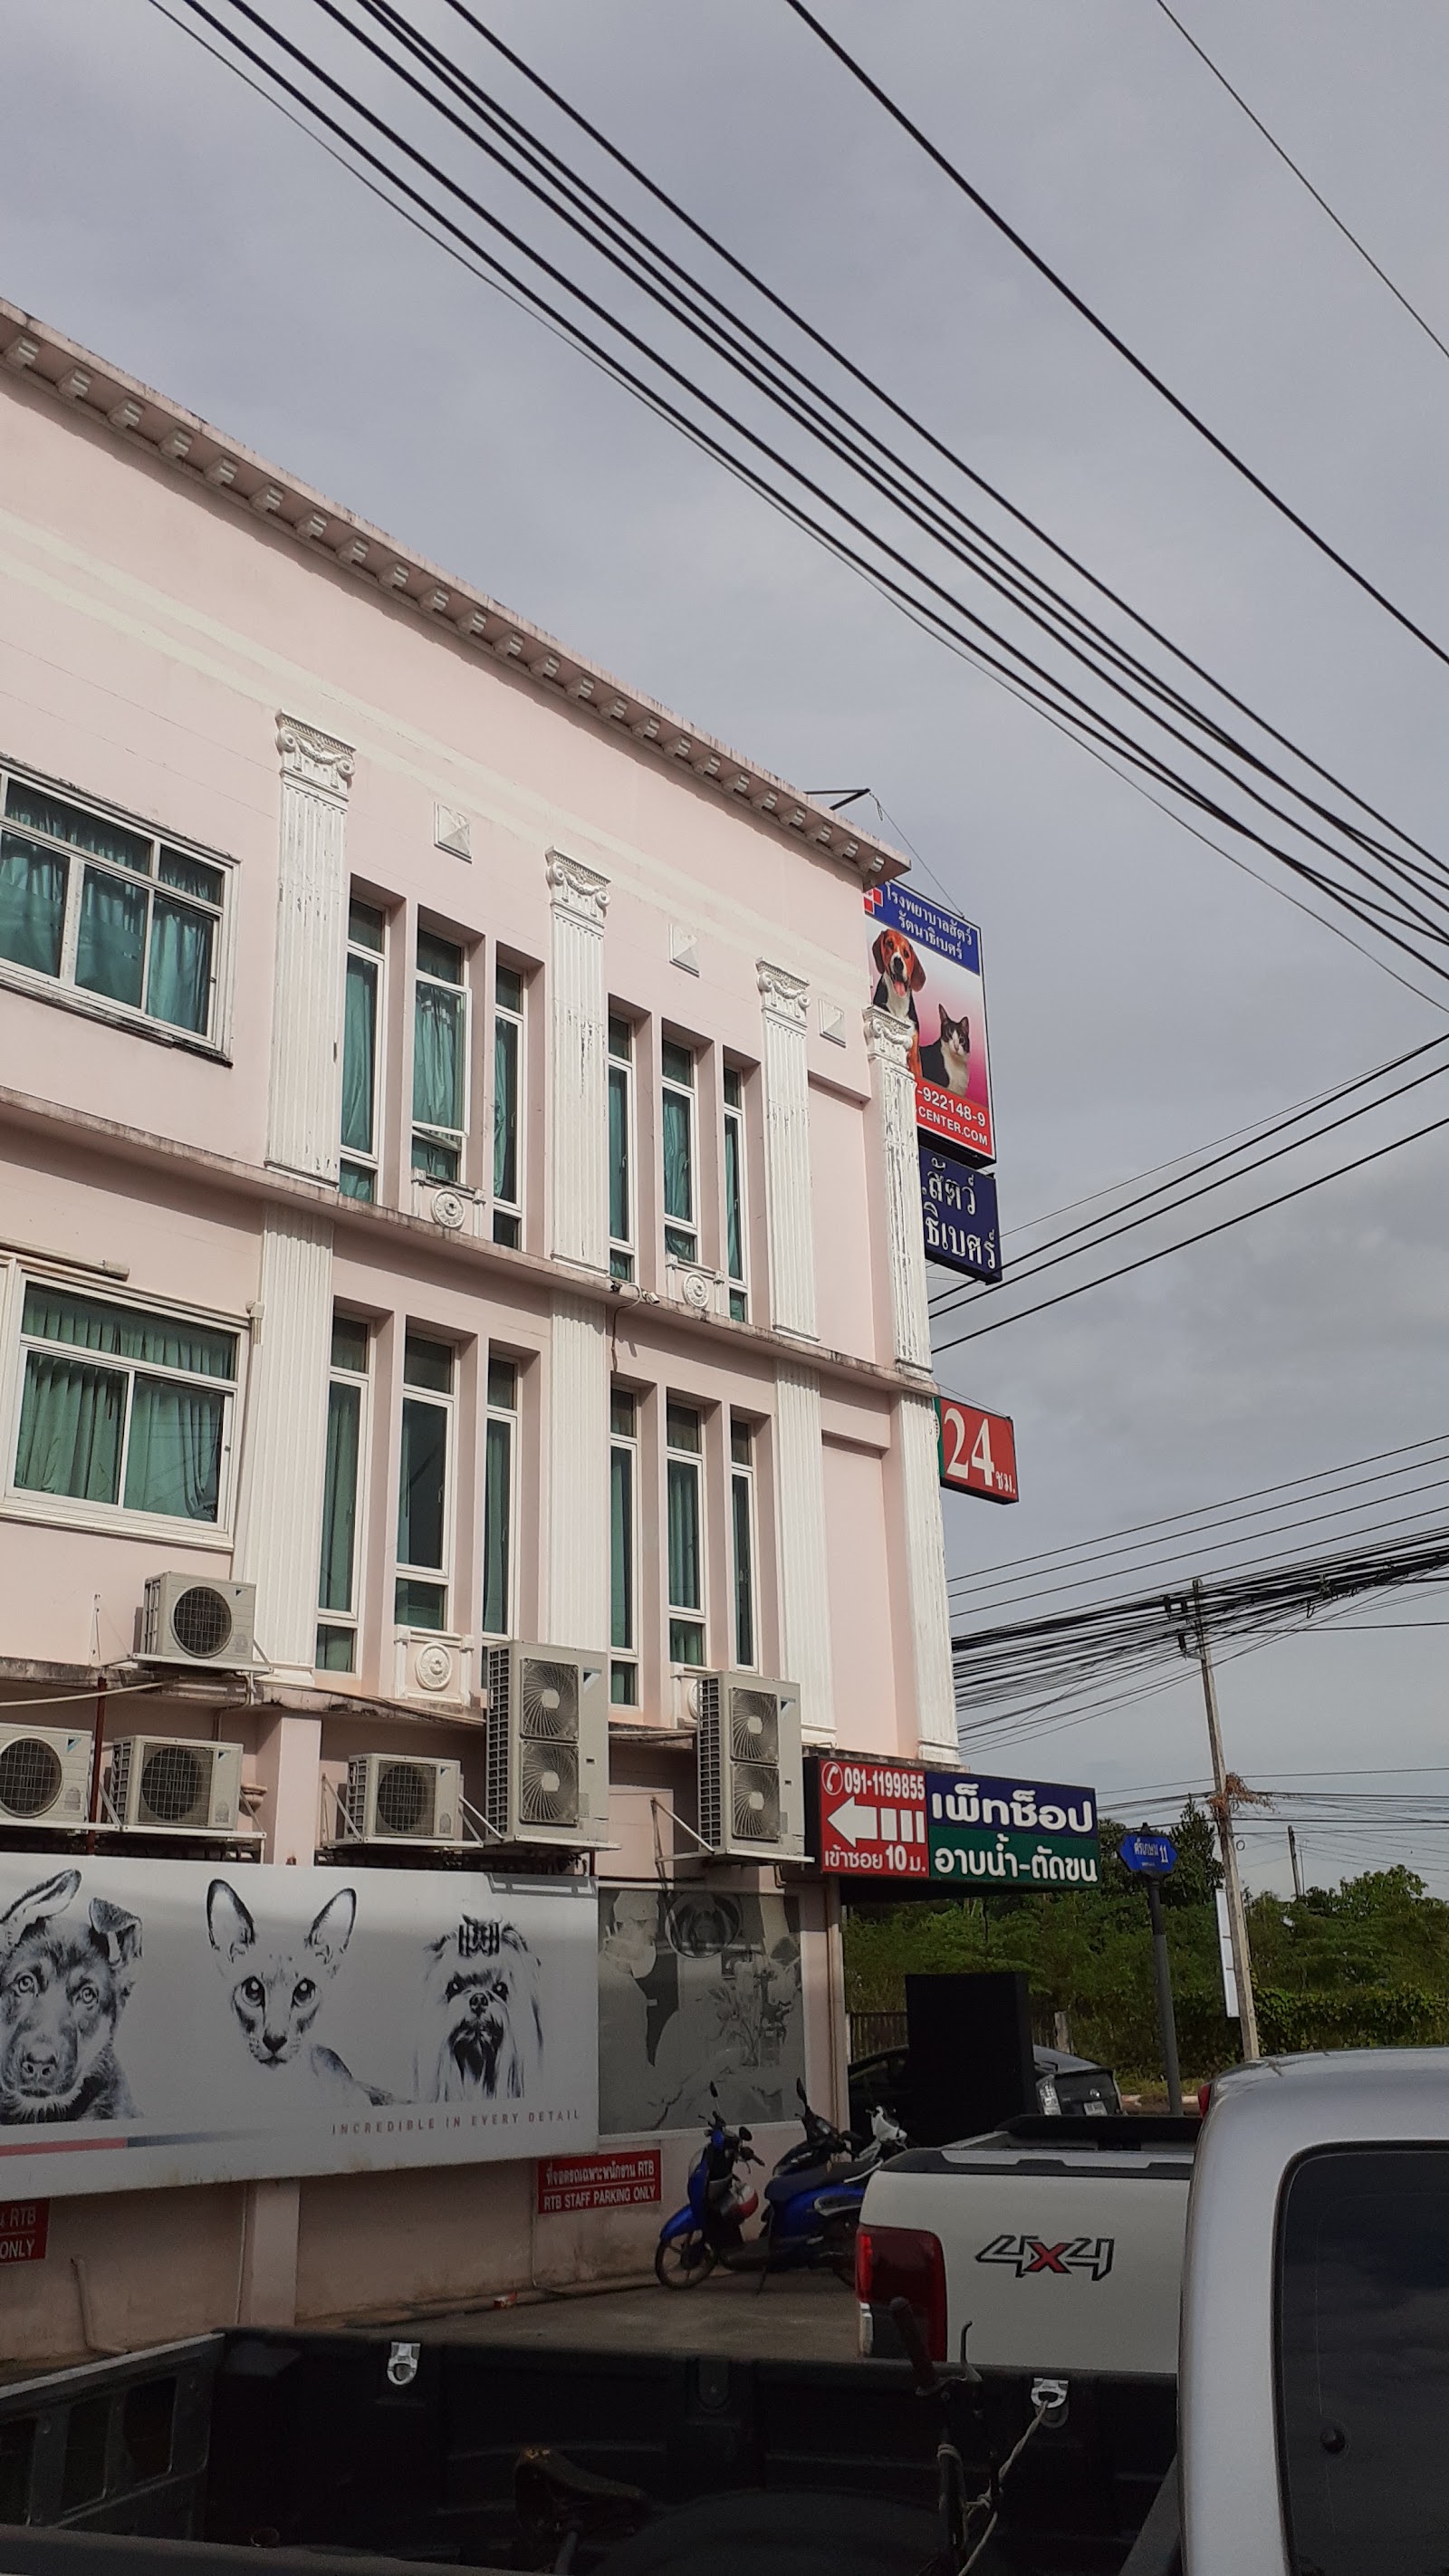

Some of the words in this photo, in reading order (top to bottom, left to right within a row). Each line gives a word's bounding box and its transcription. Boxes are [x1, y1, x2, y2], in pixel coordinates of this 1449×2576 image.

[885, 880, 972, 946] โรงพยาบาลสัตว์
[898, 909, 963, 960] รัตนาธิเบศร์
[944, 1408, 994, 1487] 24
[844, 1766, 926, 1801] 091-1199855
[931, 1783, 1093, 1832] เพ็ทช็อป
[825, 1844, 883, 1870] เข้าซอย
[885, 1843, 907, 1871] 10
[909, 1856, 926, 1872] ม.
[935, 1832, 1098, 1883] อาบน้ำ-ตัดขน
[1159, 1844, 1169, 1863] 11
[332, 2118, 435, 2135] INCREDIBLE
[446, 2115, 461, 2129] IN
[471, 2112, 518, 2127] EVERY
[528, 2109, 578, 2122] DETAIL
[638, 2159, 655, 2177] RTB
[543, 2195, 561, 2210] RTB
[564, 2192, 590, 2208] STAFF
[593, 2187, 631, 2205] PARKING
[633, 2185, 656, 2201] ONLY
[0, 2239, 35, 2260] ONLY
